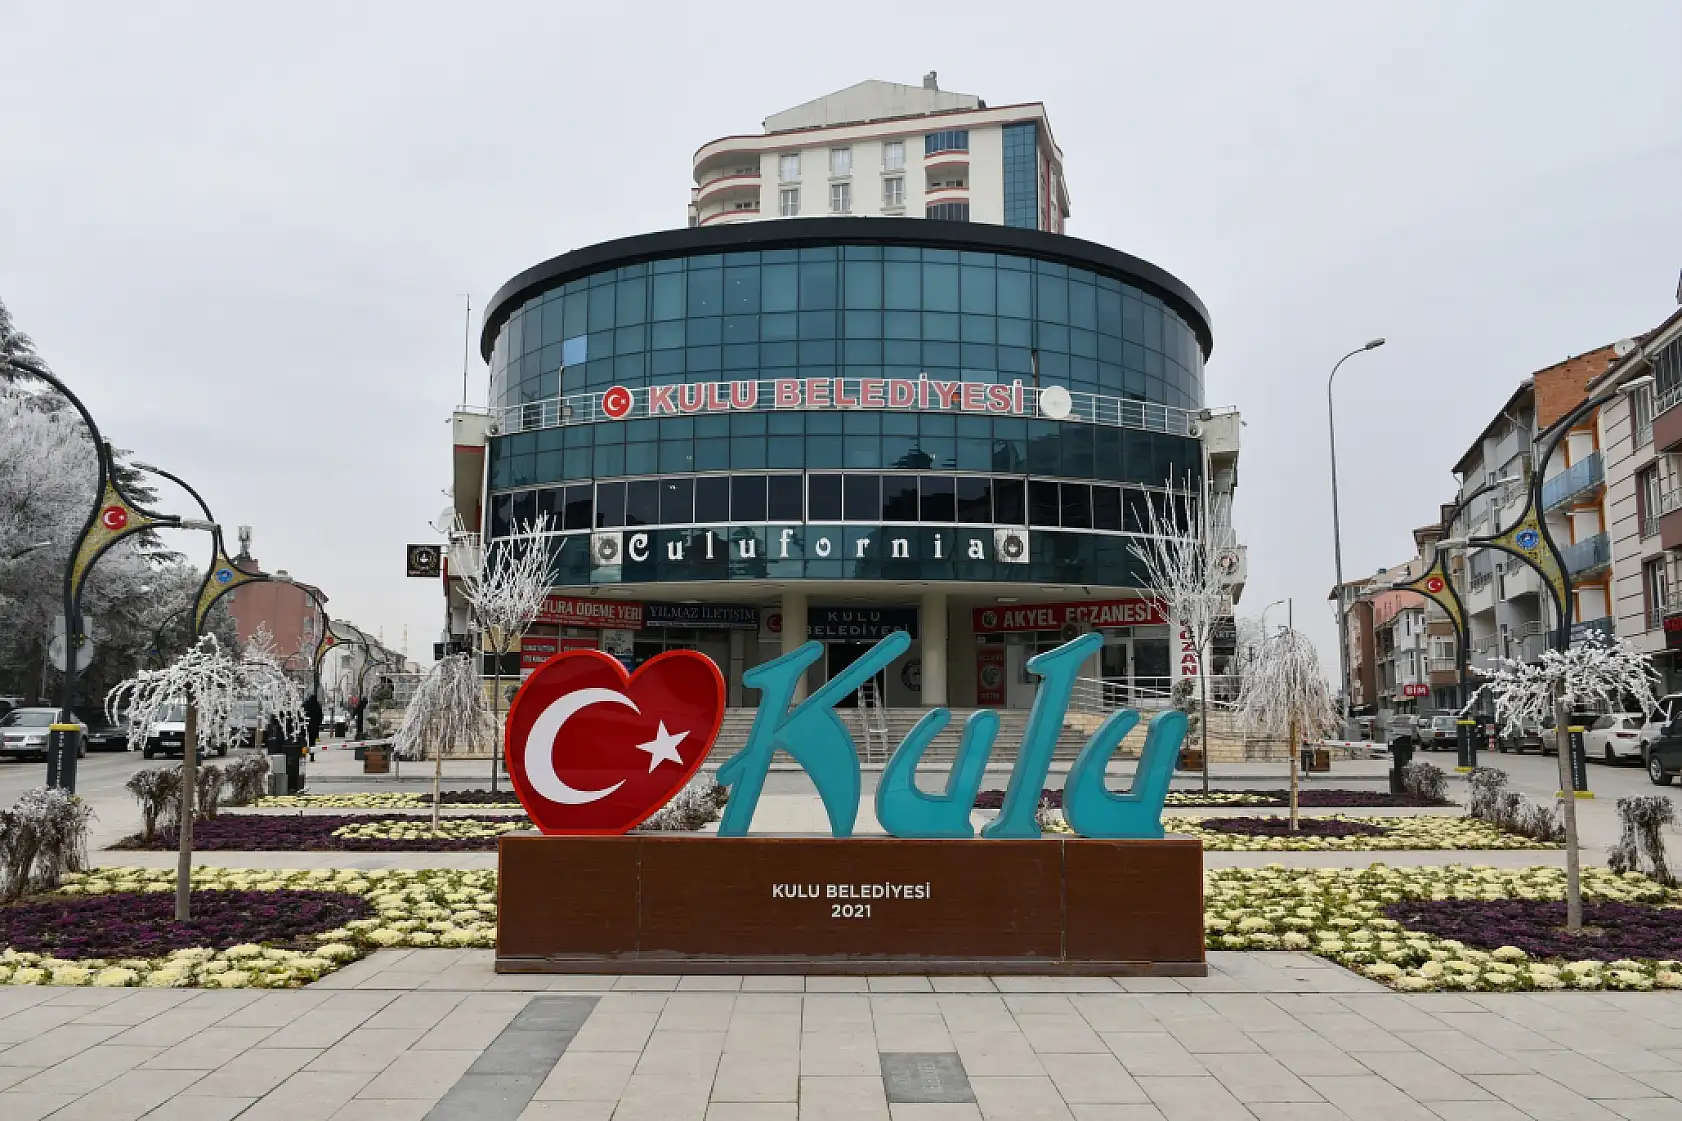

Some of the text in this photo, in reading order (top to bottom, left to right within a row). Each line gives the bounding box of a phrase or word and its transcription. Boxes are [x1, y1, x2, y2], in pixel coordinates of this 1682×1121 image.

[649, 373, 1024, 416] KULU BELEDİYESİ
[628, 528, 986, 562] Culufornia
[828, 611, 881, 622] KULU
[1004, 608, 1057, 628] AKYEL
[715, 631, 1189, 839] Kulu
[772, 881, 931, 898] KULU BELEDİYESİ
[831, 904, 871, 918] 2021
